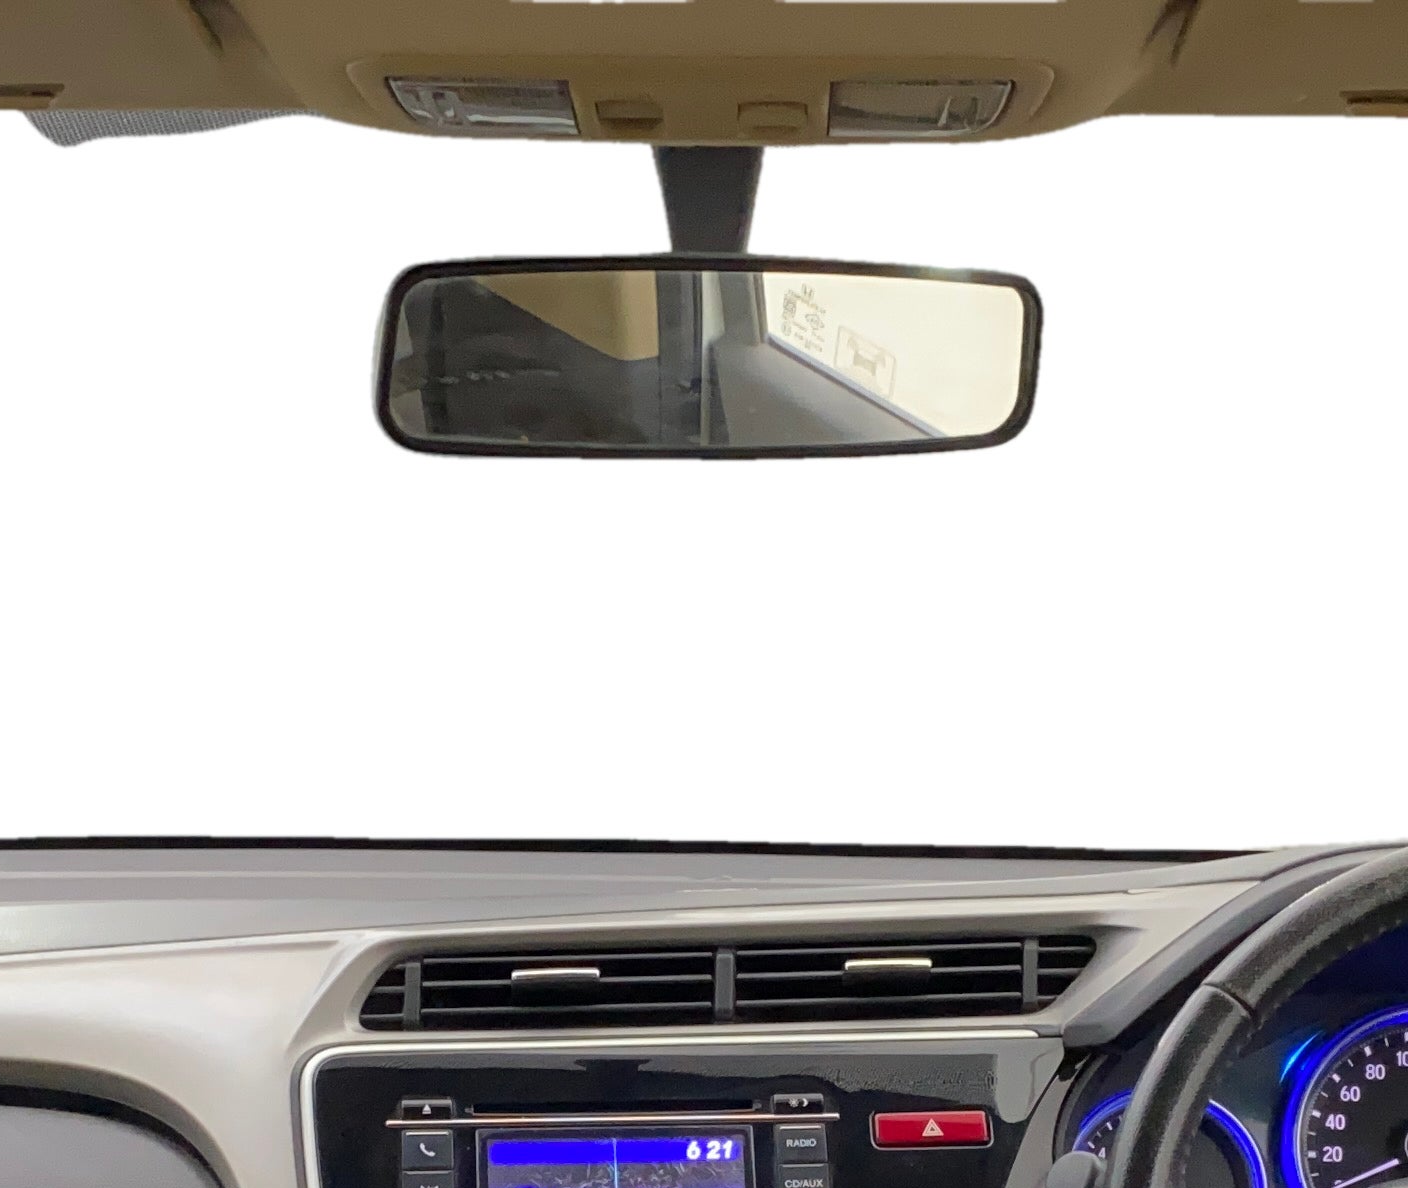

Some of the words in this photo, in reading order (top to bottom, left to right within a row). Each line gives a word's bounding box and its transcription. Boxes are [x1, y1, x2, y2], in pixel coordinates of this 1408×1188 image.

[1365, 1064, 1386, 1081] 80
[1340, 1086, 1361, 1102] 60
[1325, 1114, 1346, 1131] 40
[786, 1138, 817, 1148] RADIO
[1098, 1147, 1106, 1159] 4
[1322, 1146, 1342, 1163] 20
[784, 1178, 824, 1188] CD/AUX
